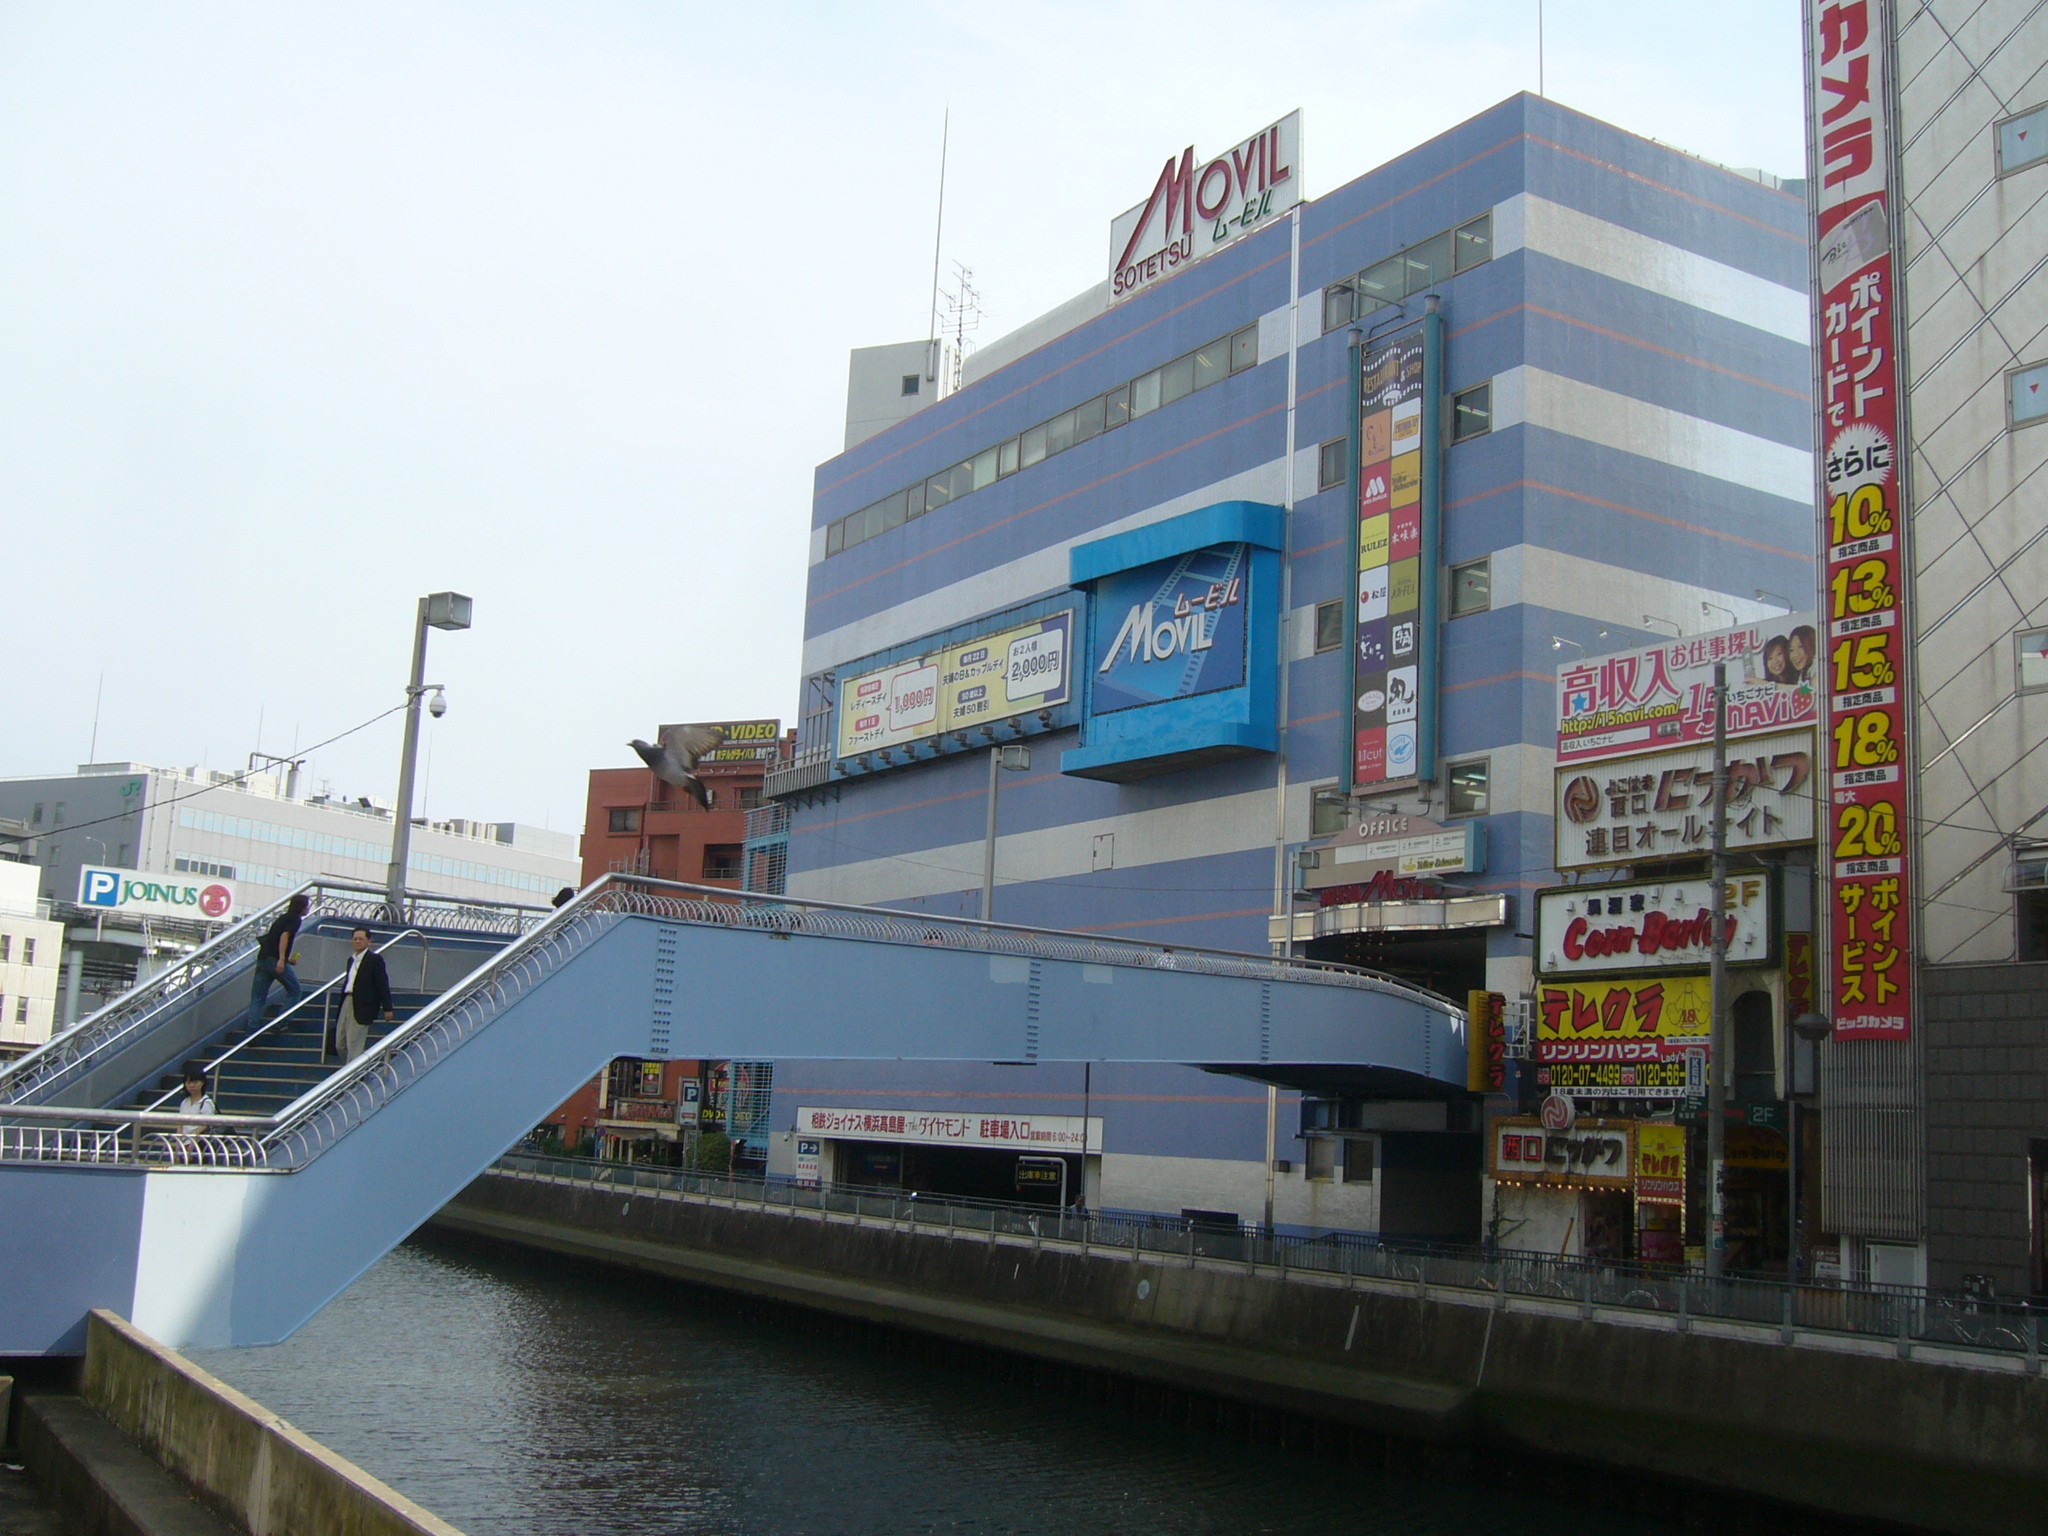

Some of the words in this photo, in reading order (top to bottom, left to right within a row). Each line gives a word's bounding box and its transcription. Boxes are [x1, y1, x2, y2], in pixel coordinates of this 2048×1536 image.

[1114, 125, 1291, 273] MOVIL
[1212, 189, 1273, 242] ムービル
[1113, 233, 1192, 296] SOTETSU
[1850, 271, 1884, 419] ポイント
[1363, 361, 1400, 395] RESTAURANT
[1406, 361, 1422, 379] SHOP
[1826, 302, 1849, 428] カードで
[1827, 437, 1890, 482] さらに
[1830, 483, 1893, 545] 10%
[1361, 537, 1389, 554] RULEZ
[1838, 539, 1880, 559] 指定商品
[1174, 577, 1242, 619] ムービル
[1831, 558, 1895, 620] 13%
[1099, 600, 1213, 675] MOVIL
[1840, 614, 1882, 633] 指定商品
[1671, 630, 1766, 668] お仕事探し
[1832, 632, 1895, 693] 15%
[1011, 651, 1060, 683] 2,000円
[1561, 649, 1681, 717] 高収入
[895, 687, 935, 715] 1,000円
[1843, 690, 1884, 708] 指定商品
[1561, 698, 1682, 735] http://15navi.com/
[1834, 711, 1898, 769] 18%
[1604, 774, 1656, 797] よこはま
[1844, 769, 1887, 785] 指定商品
[1610, 794, 1648, 818] 西口
[1834, 790, 1856, 804] 大
[1358, 816, 1409, 838] OFFICE
[1585, 806, 1784, 856] 連日オールイト
[1834, 801, 1902, 860] 20%
[1846, 859, 1889, 875] 指定商品
[88, 873, 115, 901] P
[119, 880, 198, 905] JOINUS
[1839, 882, 1867, 1006] サービス
[1871, 877, 1900, 1005] ポイント
[1541, 982, 1665, 1034] テレクラ
[1682, 1009, 1697, 1026] 18
[1836, 1015, 1905, 1030] ビックカメラ
[1542, 1043, 1659, 1060] リンリンハウス
[1661, 1050, 1686, 1064] Lady's
[1551, 1064, 1621, 1085] 0120-07-4499
[1752, 1106, 1775, 1122] 2F
[980, 1119, 1030, 1140] 駐車場入口
[801, 1142, 808, 1154] P
[1502, 1134, 1542, 1161] 西口
[1641, 1153, 1680, 1176] テレクラ
[1641, 1181, 1680, 1192] リンリンハウス
